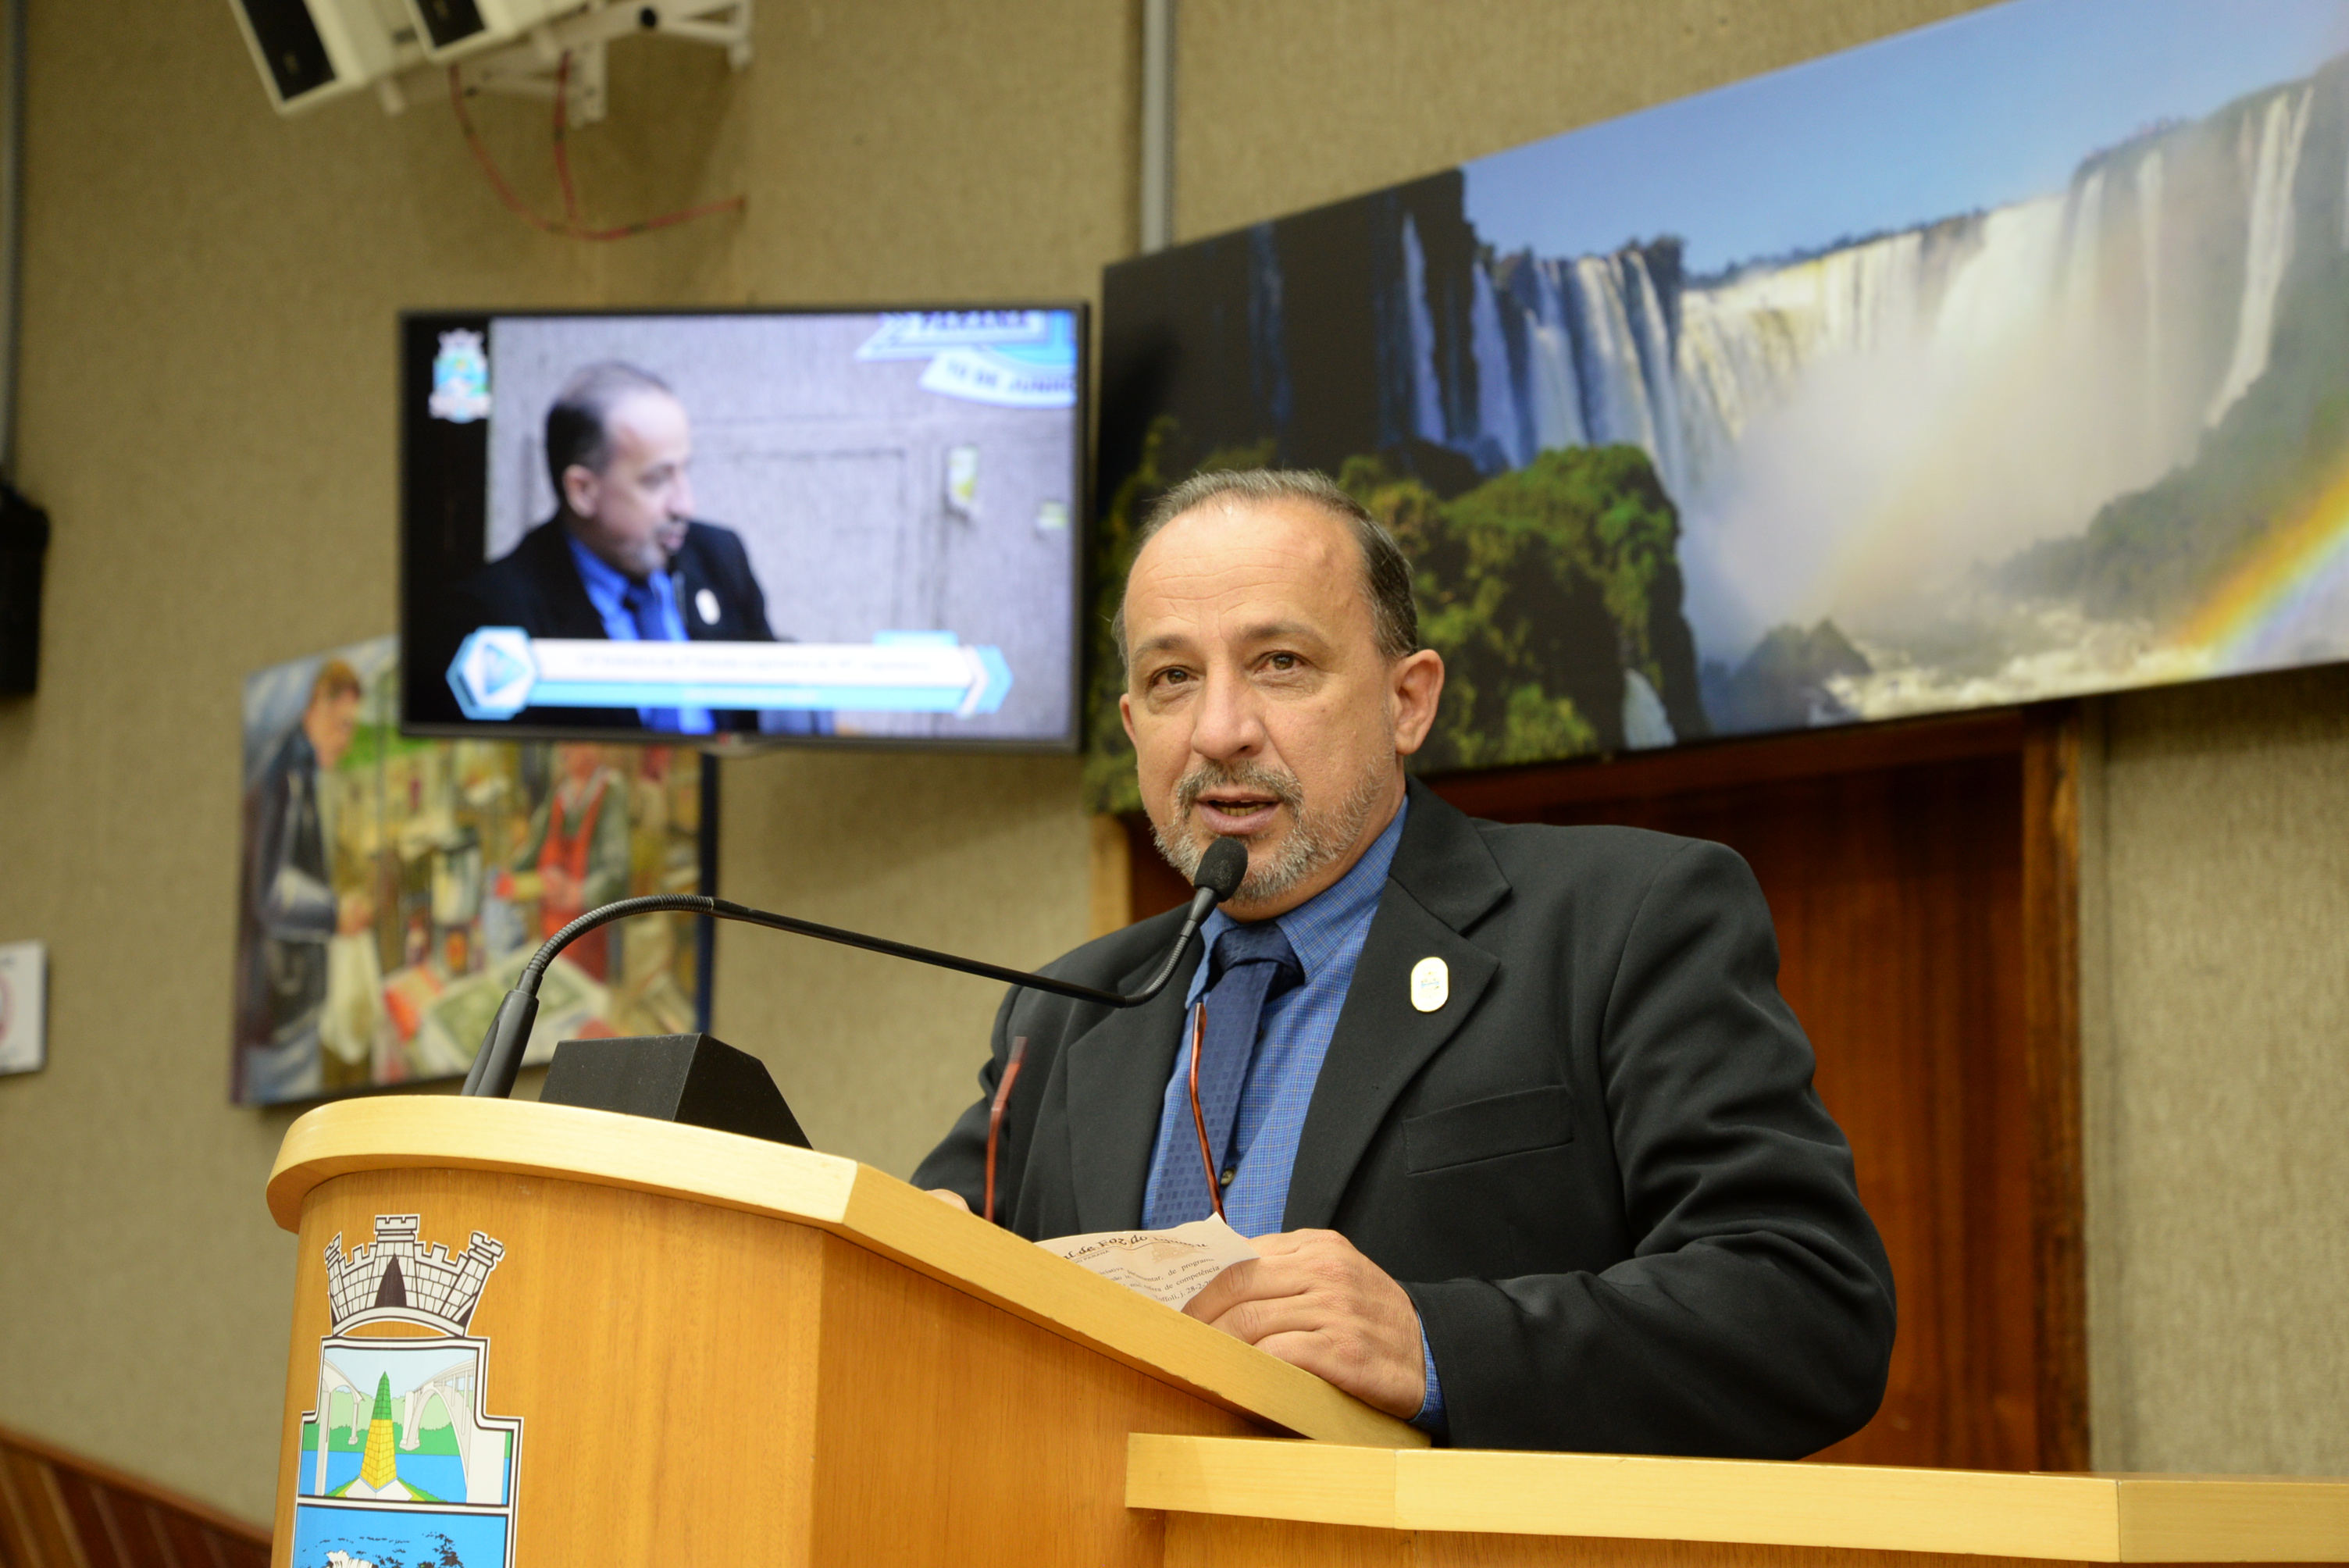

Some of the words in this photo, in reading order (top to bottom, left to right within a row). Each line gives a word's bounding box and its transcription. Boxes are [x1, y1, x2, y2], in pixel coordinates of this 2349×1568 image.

[1098, 1238, 1127, 1247] Foz
[1130, 1235, 1148, 1245] do
[1176, 1265, 1220, 1286] competência
